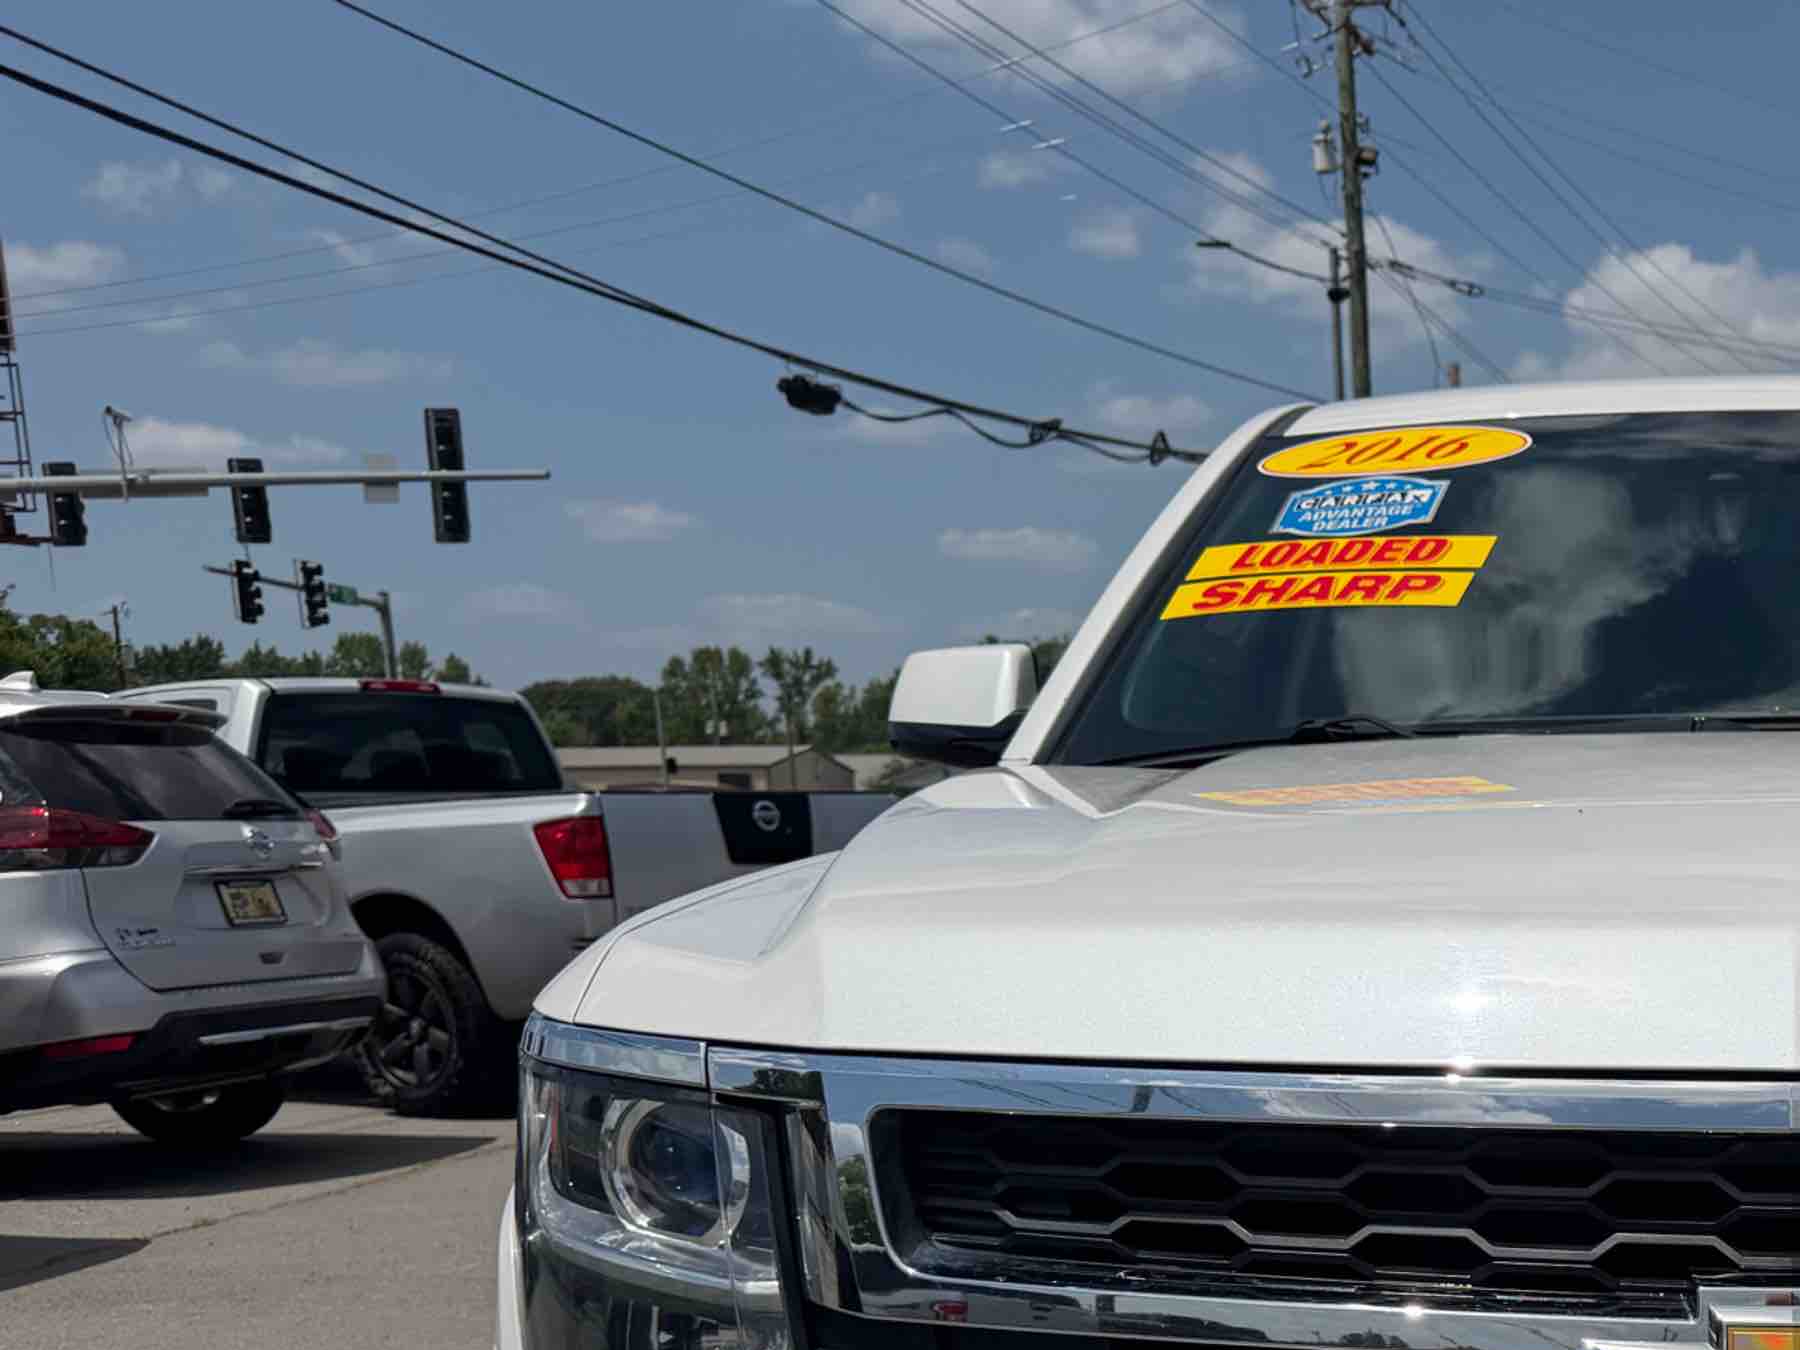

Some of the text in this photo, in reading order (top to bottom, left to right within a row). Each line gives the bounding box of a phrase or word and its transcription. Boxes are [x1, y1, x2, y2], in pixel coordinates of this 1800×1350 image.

[1296, 433, 1476, 470] 2016
[1295, 489, 1434, 509] CARFAX
[1298, 504, 1414, 522] ADVANTAGE
[1312, 517, 1389, 532] DEALER
[1230, 538, 1451, 571] LOADED
[1192, 575, 1442, 611] SHARP
